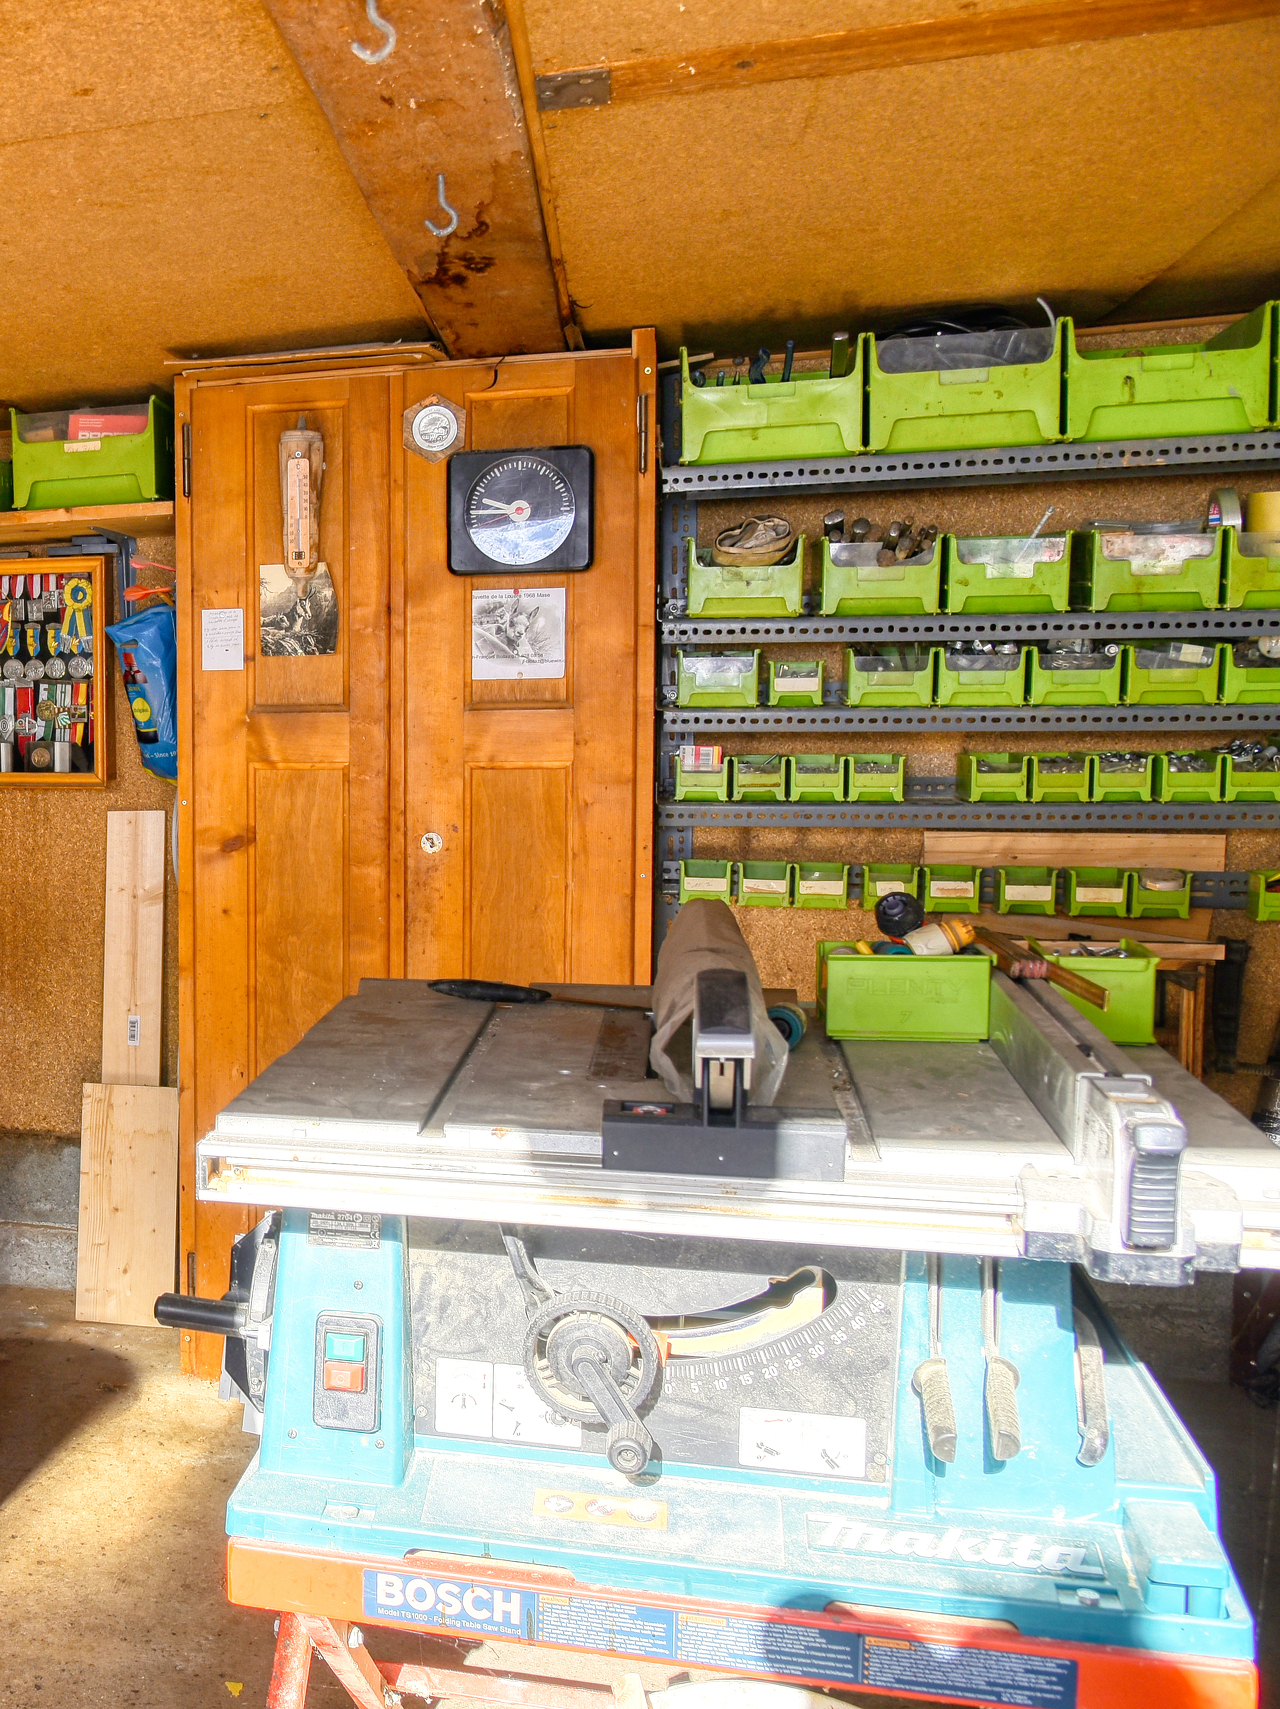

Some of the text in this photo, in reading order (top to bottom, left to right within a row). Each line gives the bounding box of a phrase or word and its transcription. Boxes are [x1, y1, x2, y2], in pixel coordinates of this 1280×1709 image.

[846, 977, 967, 996] PLENTY
[336, 1213, 353, 1221] 2704
[818, 1515, 1104, 1576] makita
[376, 1572, 521, 1625] BOSCH
[377, 1606, 400, 1617] Model
[400, 1610, 428, 1621] TS1000
[433, 1615, 461, 1628] Folding
[461, 1619, 481, 1629] Table
[482, 1623, 499, 1632] Saw
[499, 1625, 522, 1636] Stand
